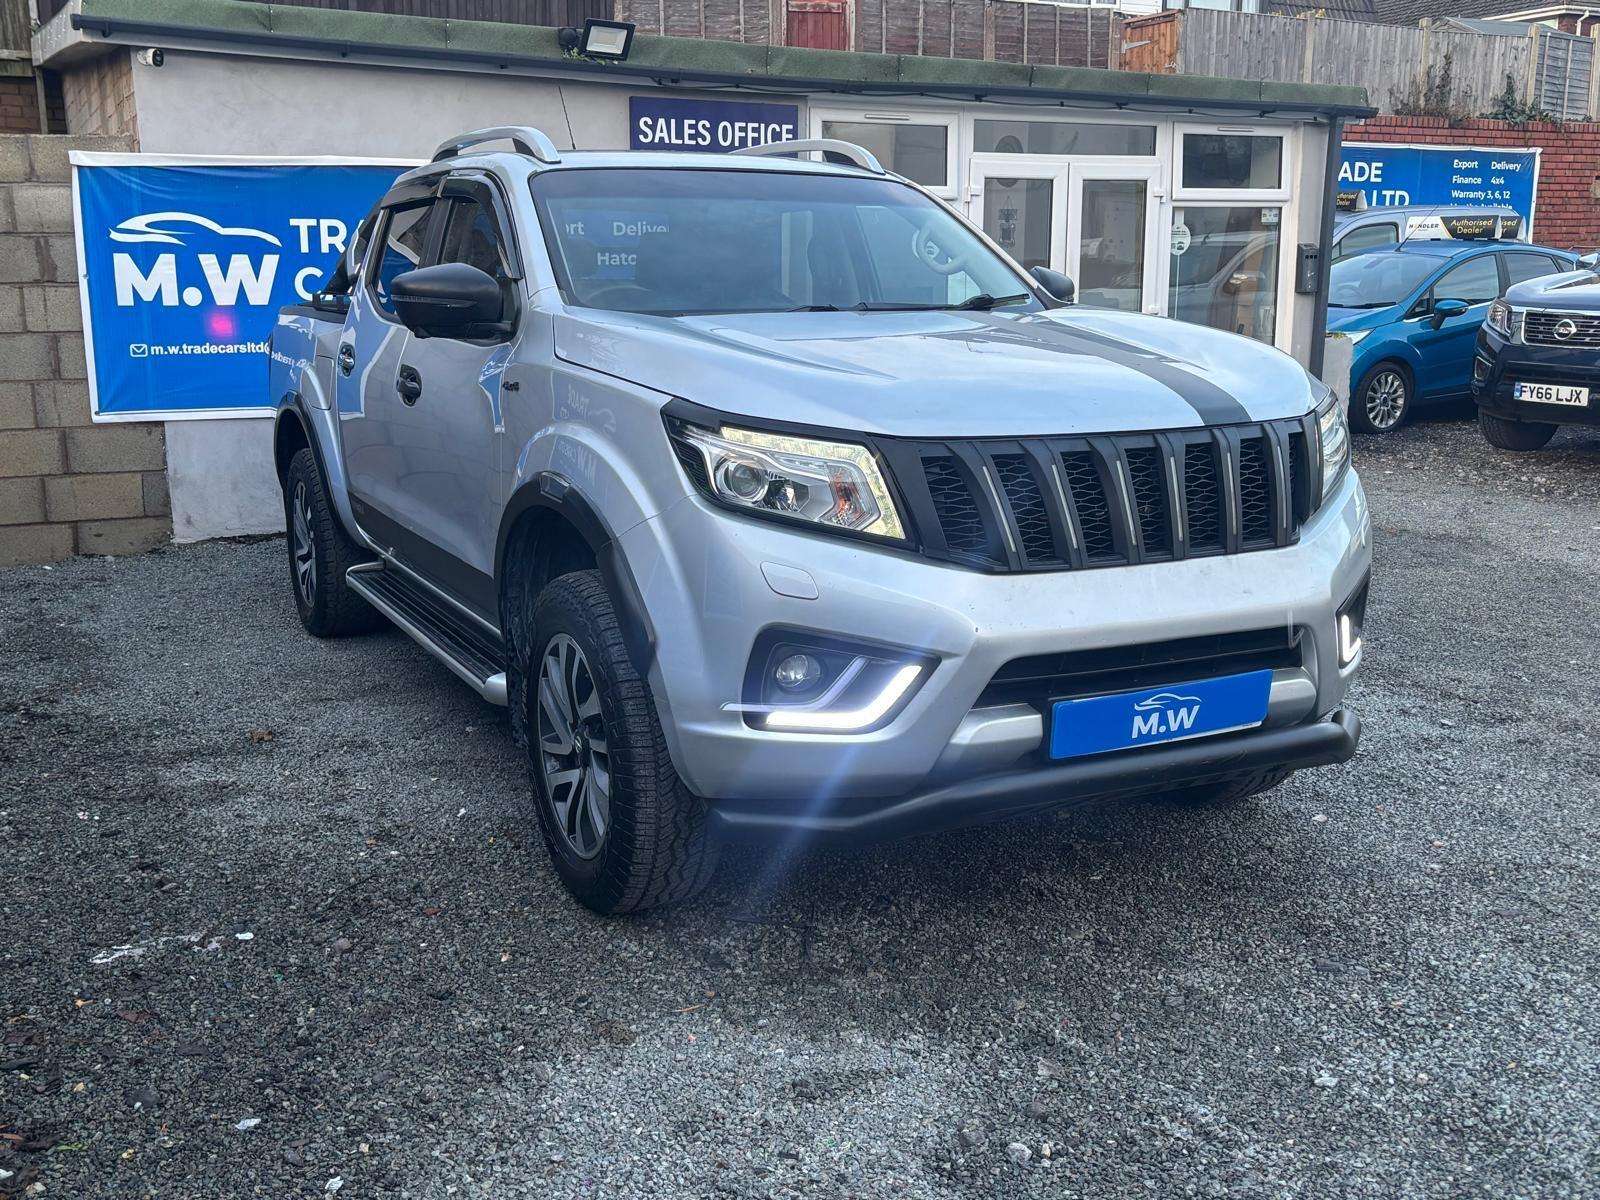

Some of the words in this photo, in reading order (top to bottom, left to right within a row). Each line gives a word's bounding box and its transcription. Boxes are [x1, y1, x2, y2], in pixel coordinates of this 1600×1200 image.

[638, 117, 711, 146] SALES
[717, 121, 794, 147] OFFICE
[1453, 159, 1479, 169] Export
[1491, 161, 1522, 172] Delivery
[1337, 161, 1384, 182] ADE
[1452, 175, 1482, 185] Finance
[1490, 176, 1505, 185] 4x4
[1451, 189, 1486, 200] Warranty
[1486, 190, 1494, 200] 3,
[1494, 191, 1502, 200] 6,
[1503, 191, 1511, 199] 12
[1450, 218, 1494, 226] Authorised
[289, 218, 362, 253] TR
[1456, 226, 1484, 234] Dealer
[112, 252, 281, 307] M.W
[1520, 384, 1553, 400] FY66
[1556, 388, 1582, 403] LJX
[1131, 705, 1201, 739] M.W
